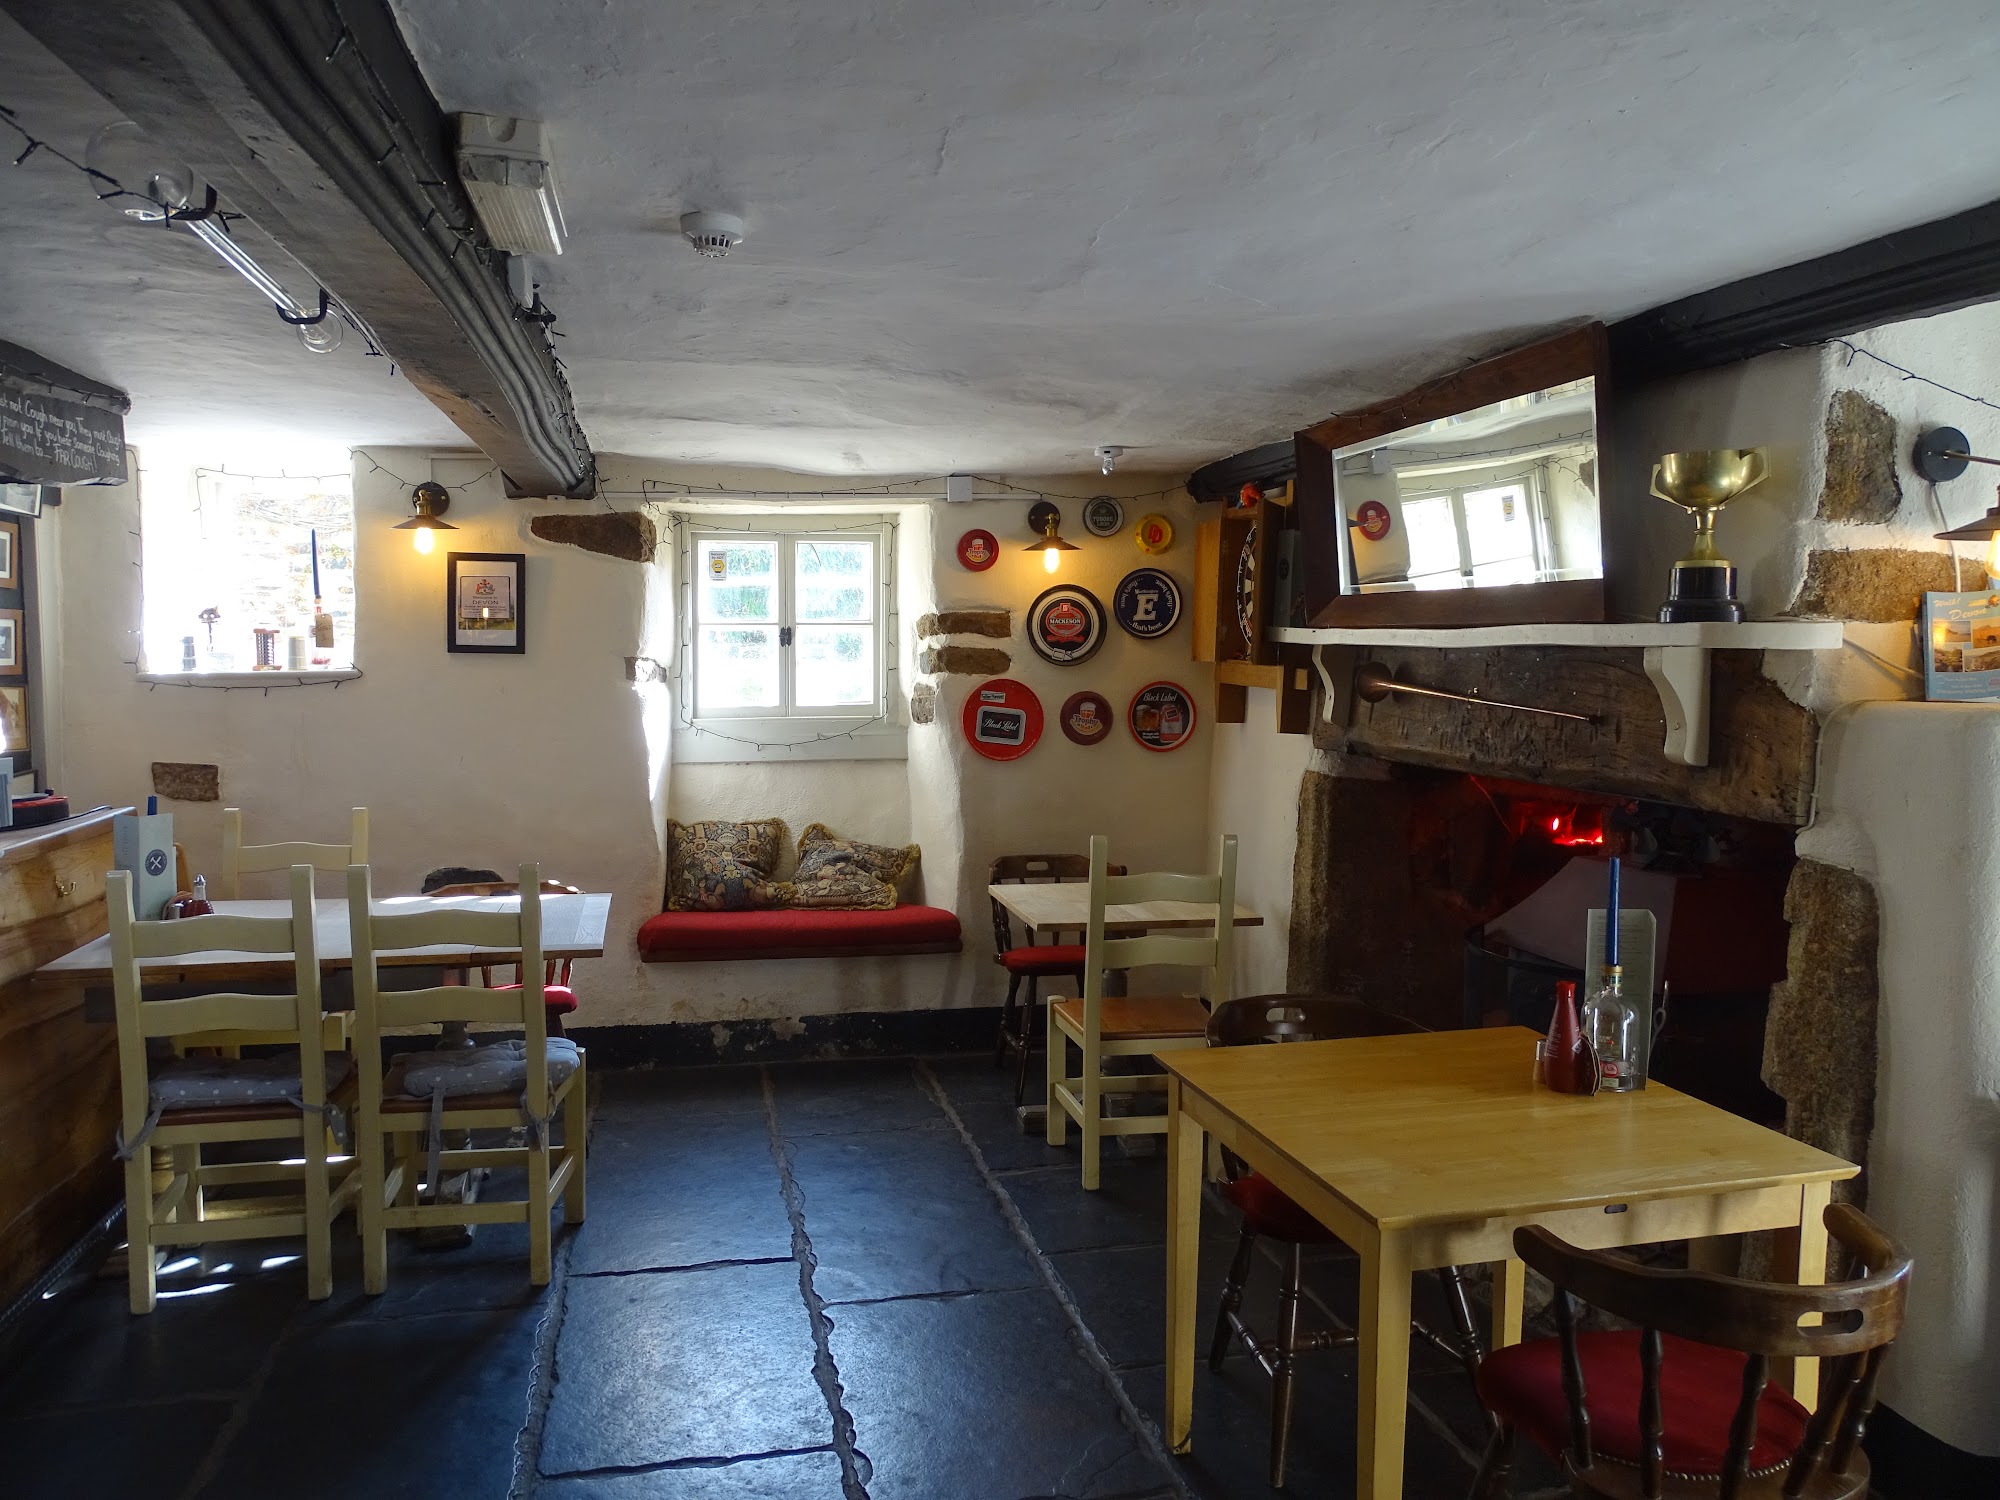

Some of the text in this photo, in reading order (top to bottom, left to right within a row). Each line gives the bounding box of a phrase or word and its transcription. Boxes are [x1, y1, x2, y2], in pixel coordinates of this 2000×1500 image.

[10, 397, 23, 414] not
[25, 400, 48, 429] Cough
[49, 414, 64, 428] near
[20, 421, 34, 440] you
[44, 430, 58, 447] you
[1132, 593, 1159, 621] E
[1949, 608, 1987, 620] Devon
[1143, 692, 1178, 702] Black Label
[982, 718, 1020, 732] Black Label
[1073, 714, 1100, 726] Trophy
